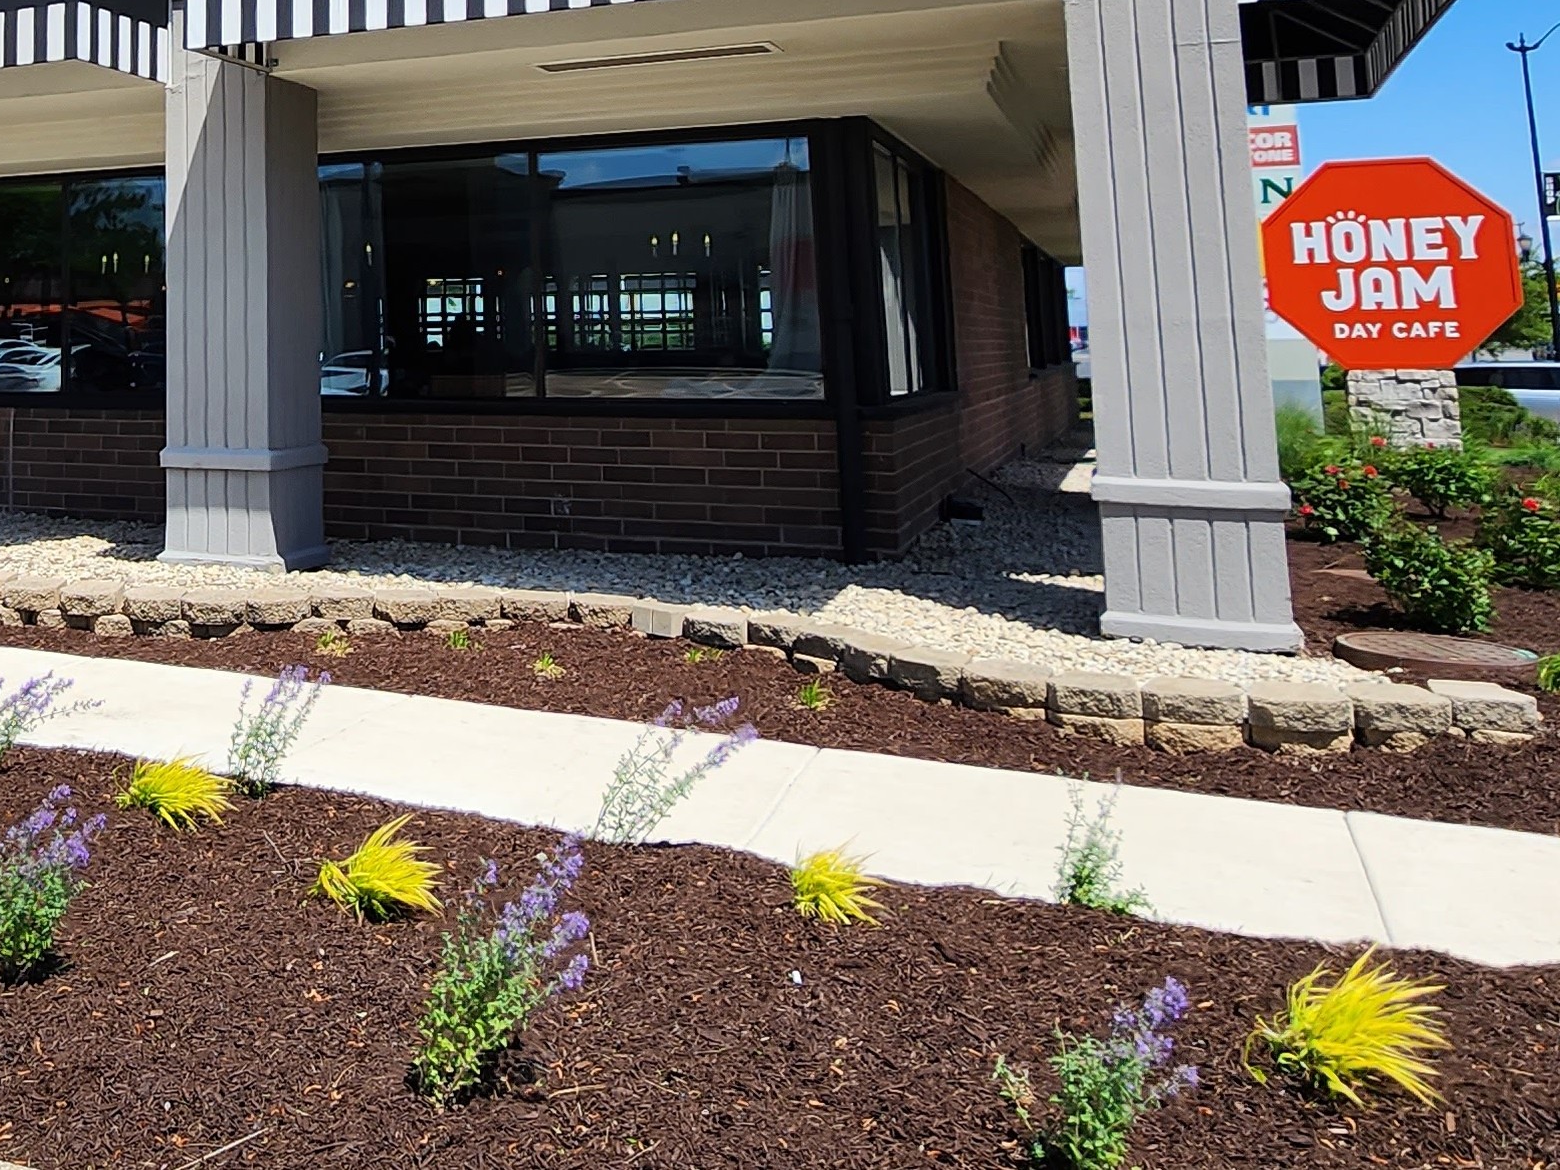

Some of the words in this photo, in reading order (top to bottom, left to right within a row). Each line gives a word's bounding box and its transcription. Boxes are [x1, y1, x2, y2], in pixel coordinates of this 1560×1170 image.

[1289, 214, 1485, 264] HONEY
[1320, 266, 1458, 312] JAM
[1333, 323, 1383, 339] DAY
[1392, 321, 1461, 339] CAFE
